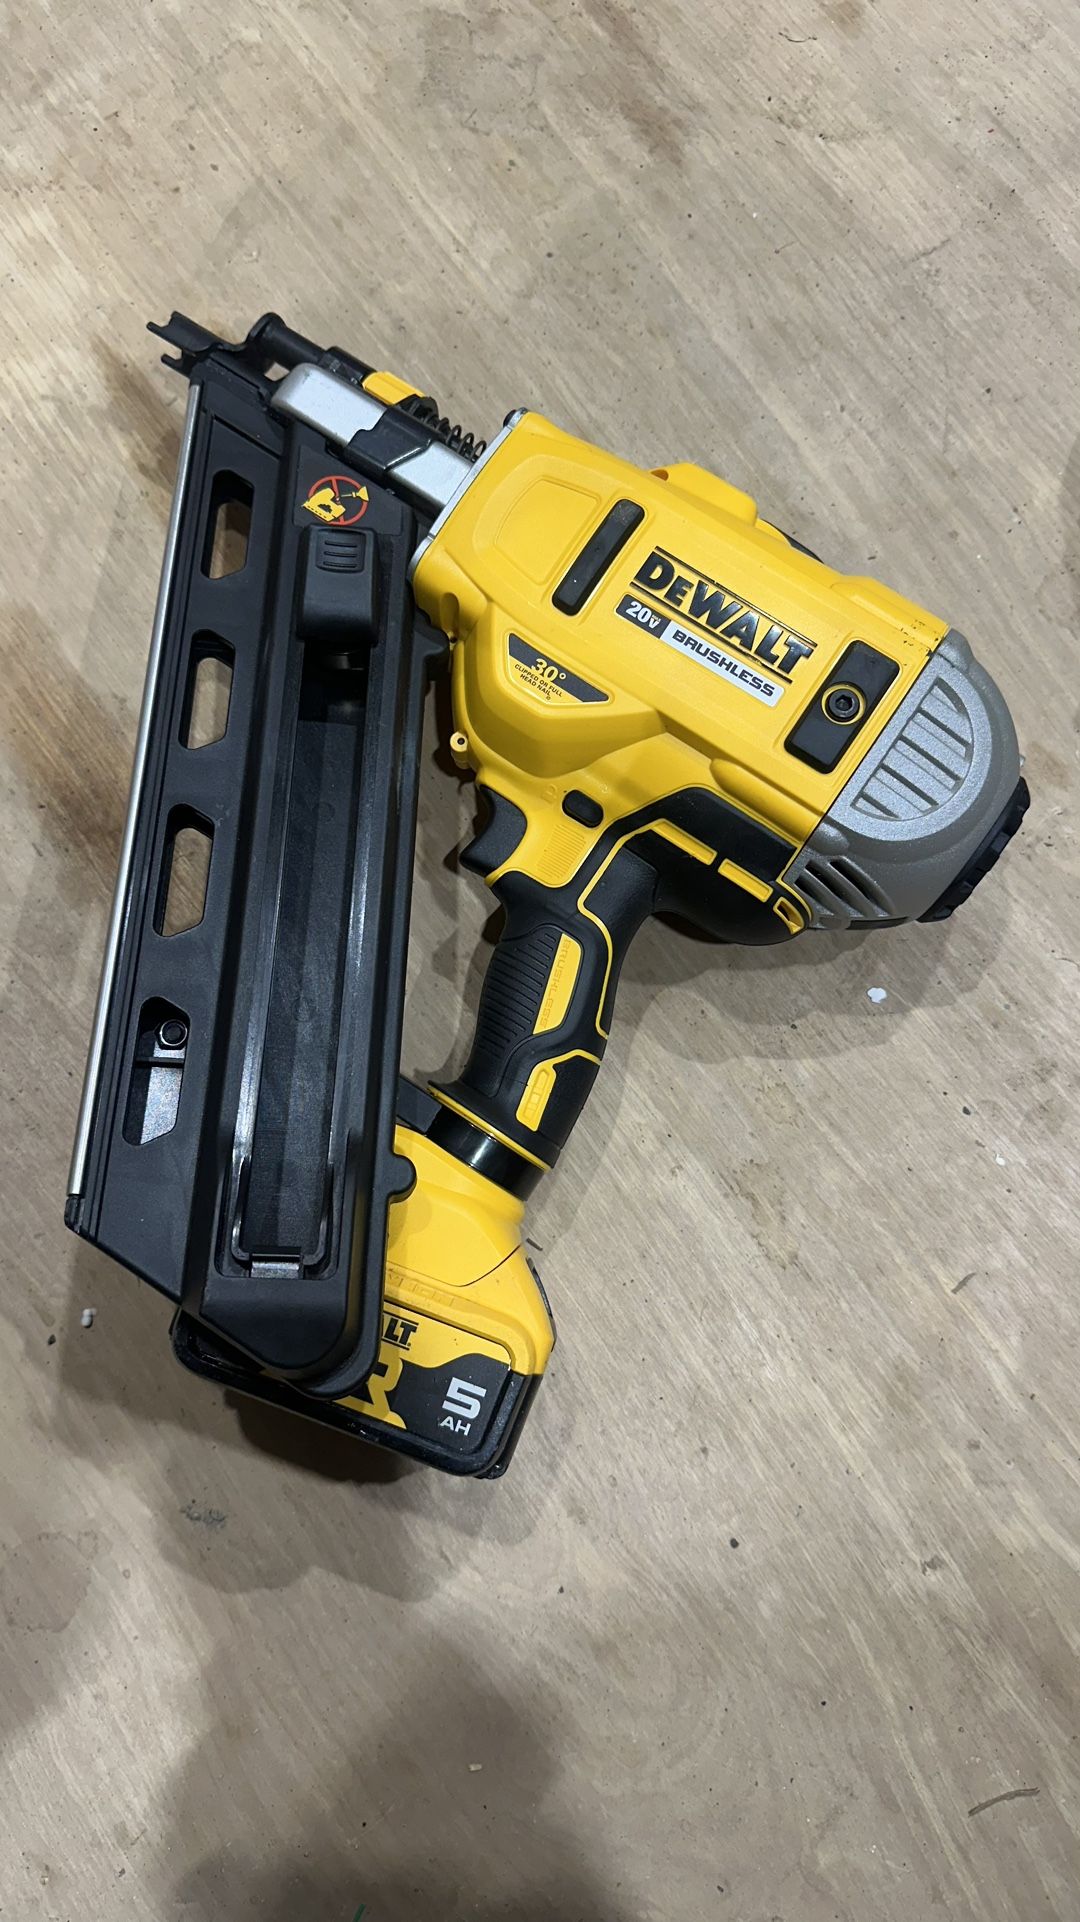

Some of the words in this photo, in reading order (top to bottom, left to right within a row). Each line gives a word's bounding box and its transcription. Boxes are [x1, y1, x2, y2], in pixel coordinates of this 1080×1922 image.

[633, 551, 814, 674] DEWALT
[514, 664, 538, 681] CLIPPED
[539, 679, 549, 688] OR
[549, 685, 562, 697] FULL
[520, 674, 536, 686] HEAD
[672, 630, 775, 697] BRUSHLESS
[540, 938, 571, 1028] BRUSHLESS
[442, 1377, 487, 1420] 5
[440, 1415, 471, 1436] AH
